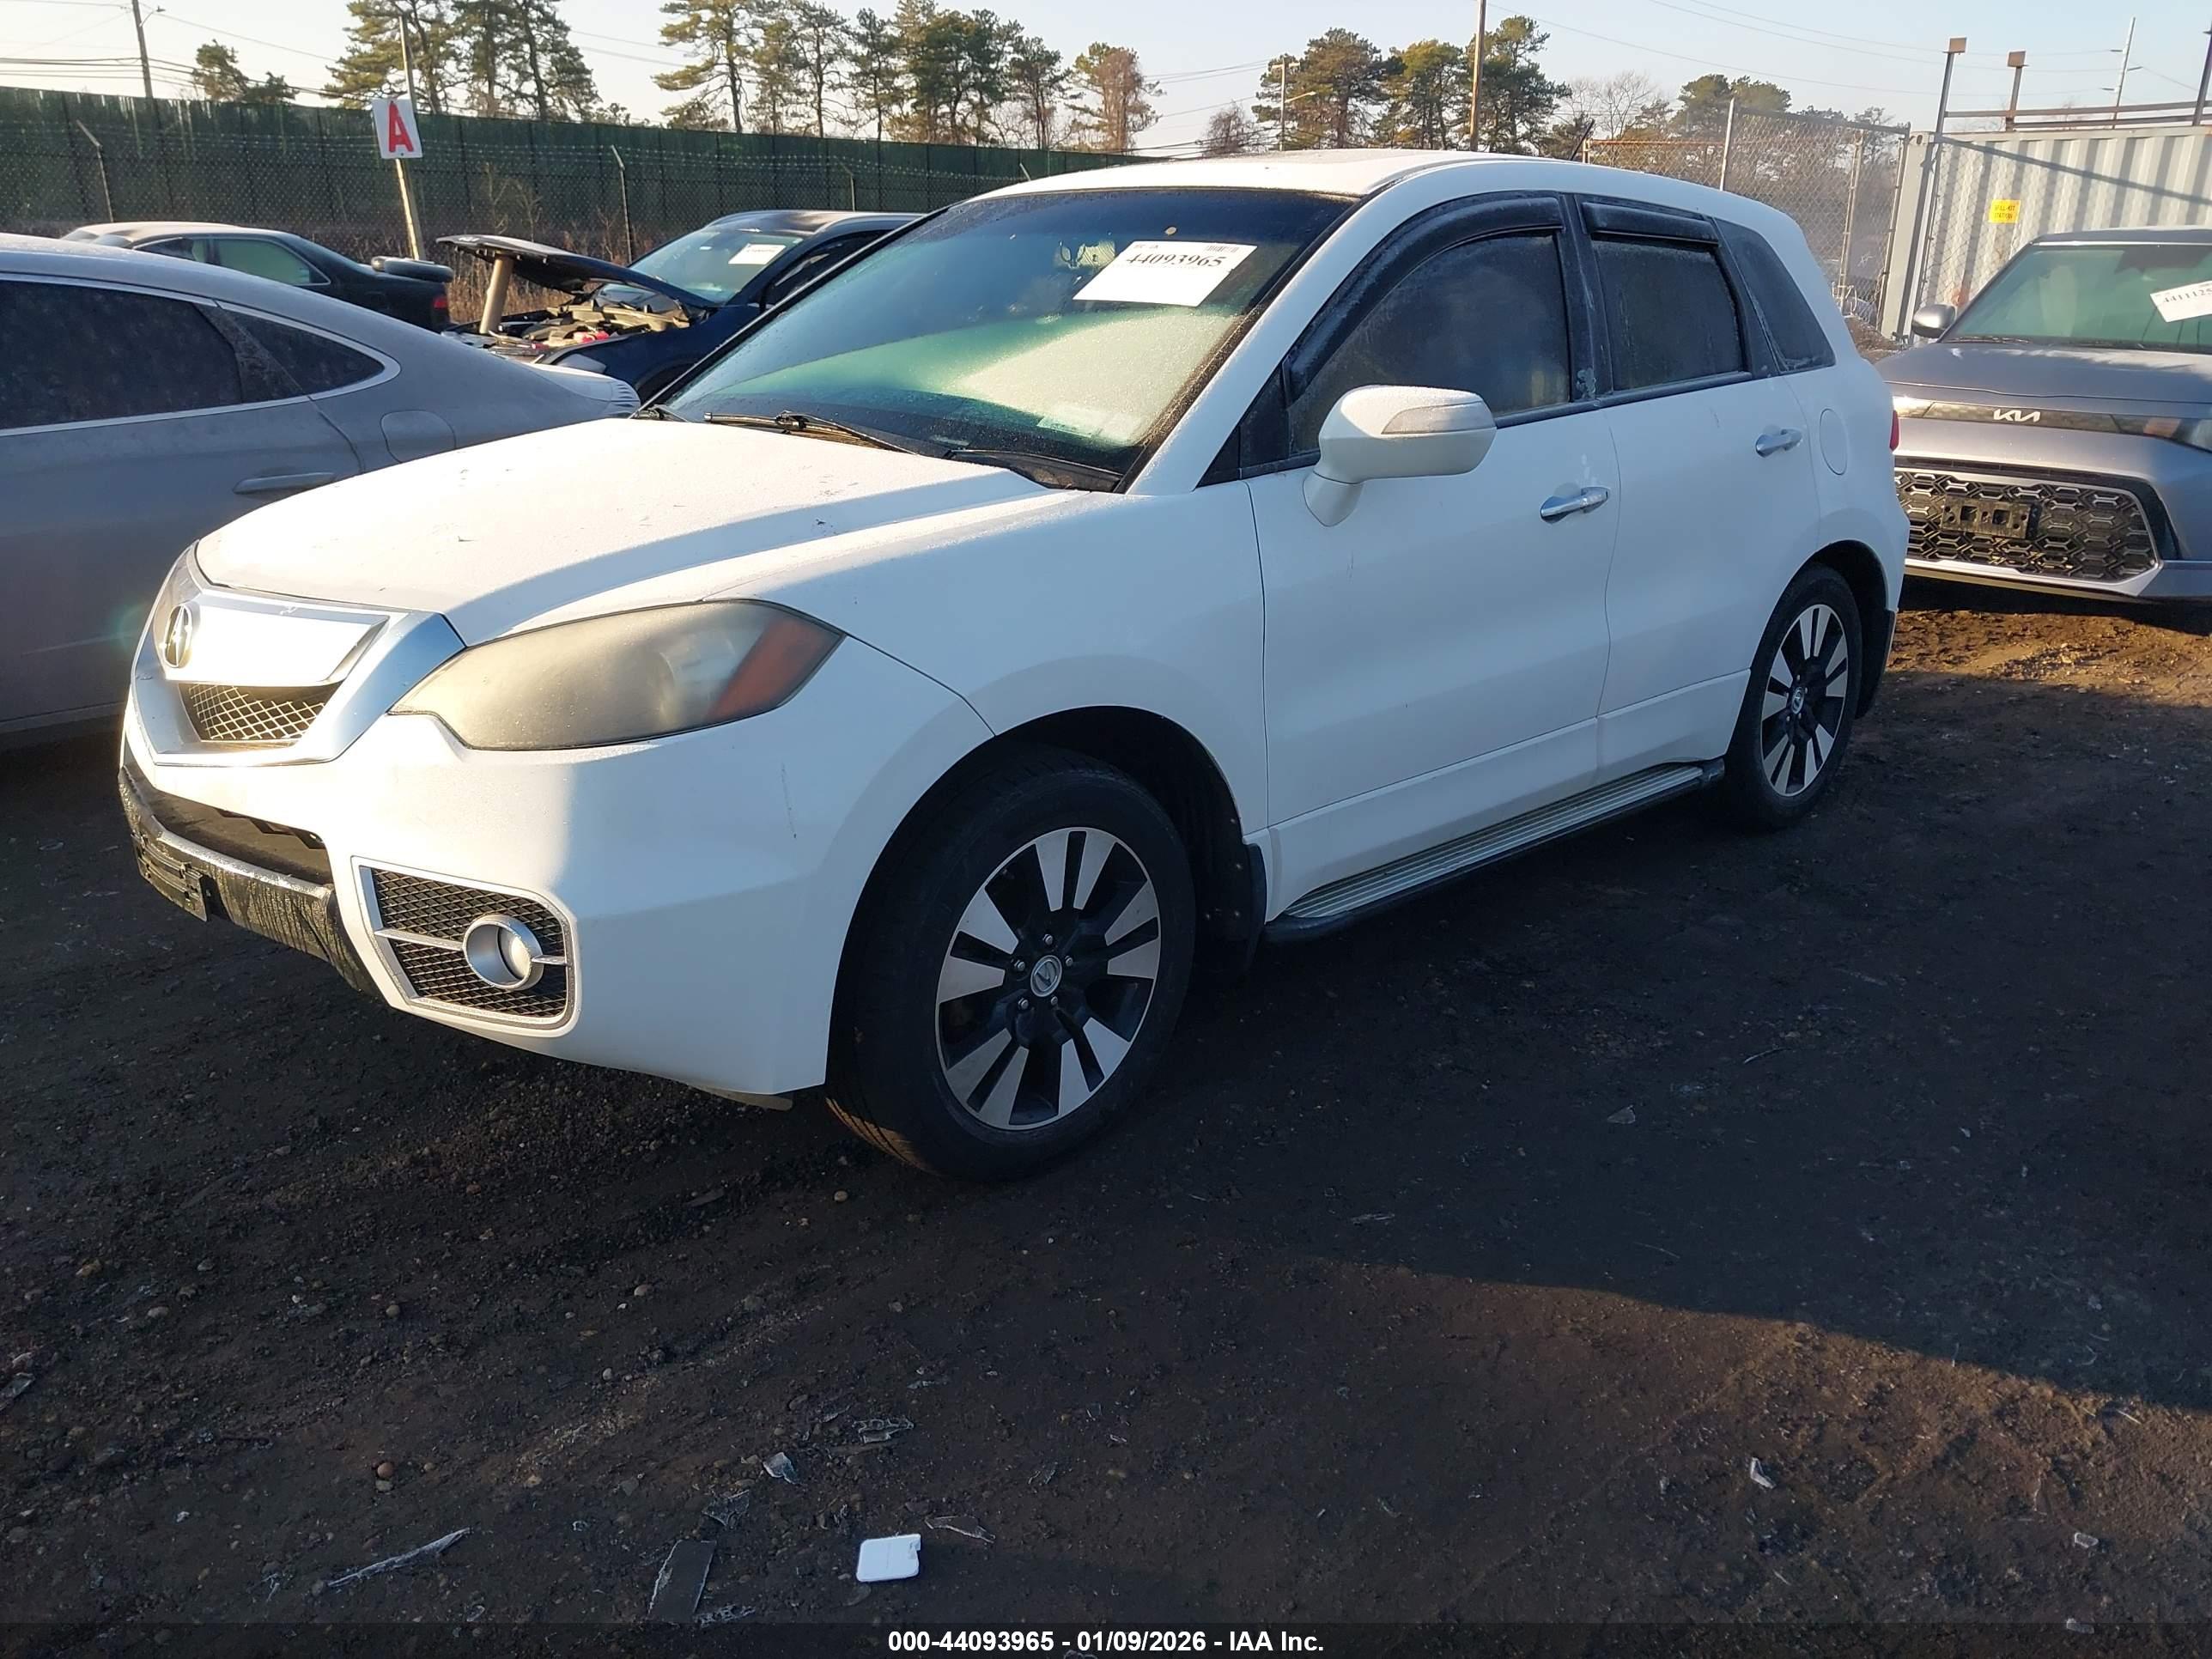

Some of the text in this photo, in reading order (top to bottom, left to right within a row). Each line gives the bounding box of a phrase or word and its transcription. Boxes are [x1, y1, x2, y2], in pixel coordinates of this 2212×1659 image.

[388, 101, 414, 153] A
[1127, 252, 1227, 267] 44093965
[1993, 408, 2041, 423] KIA
